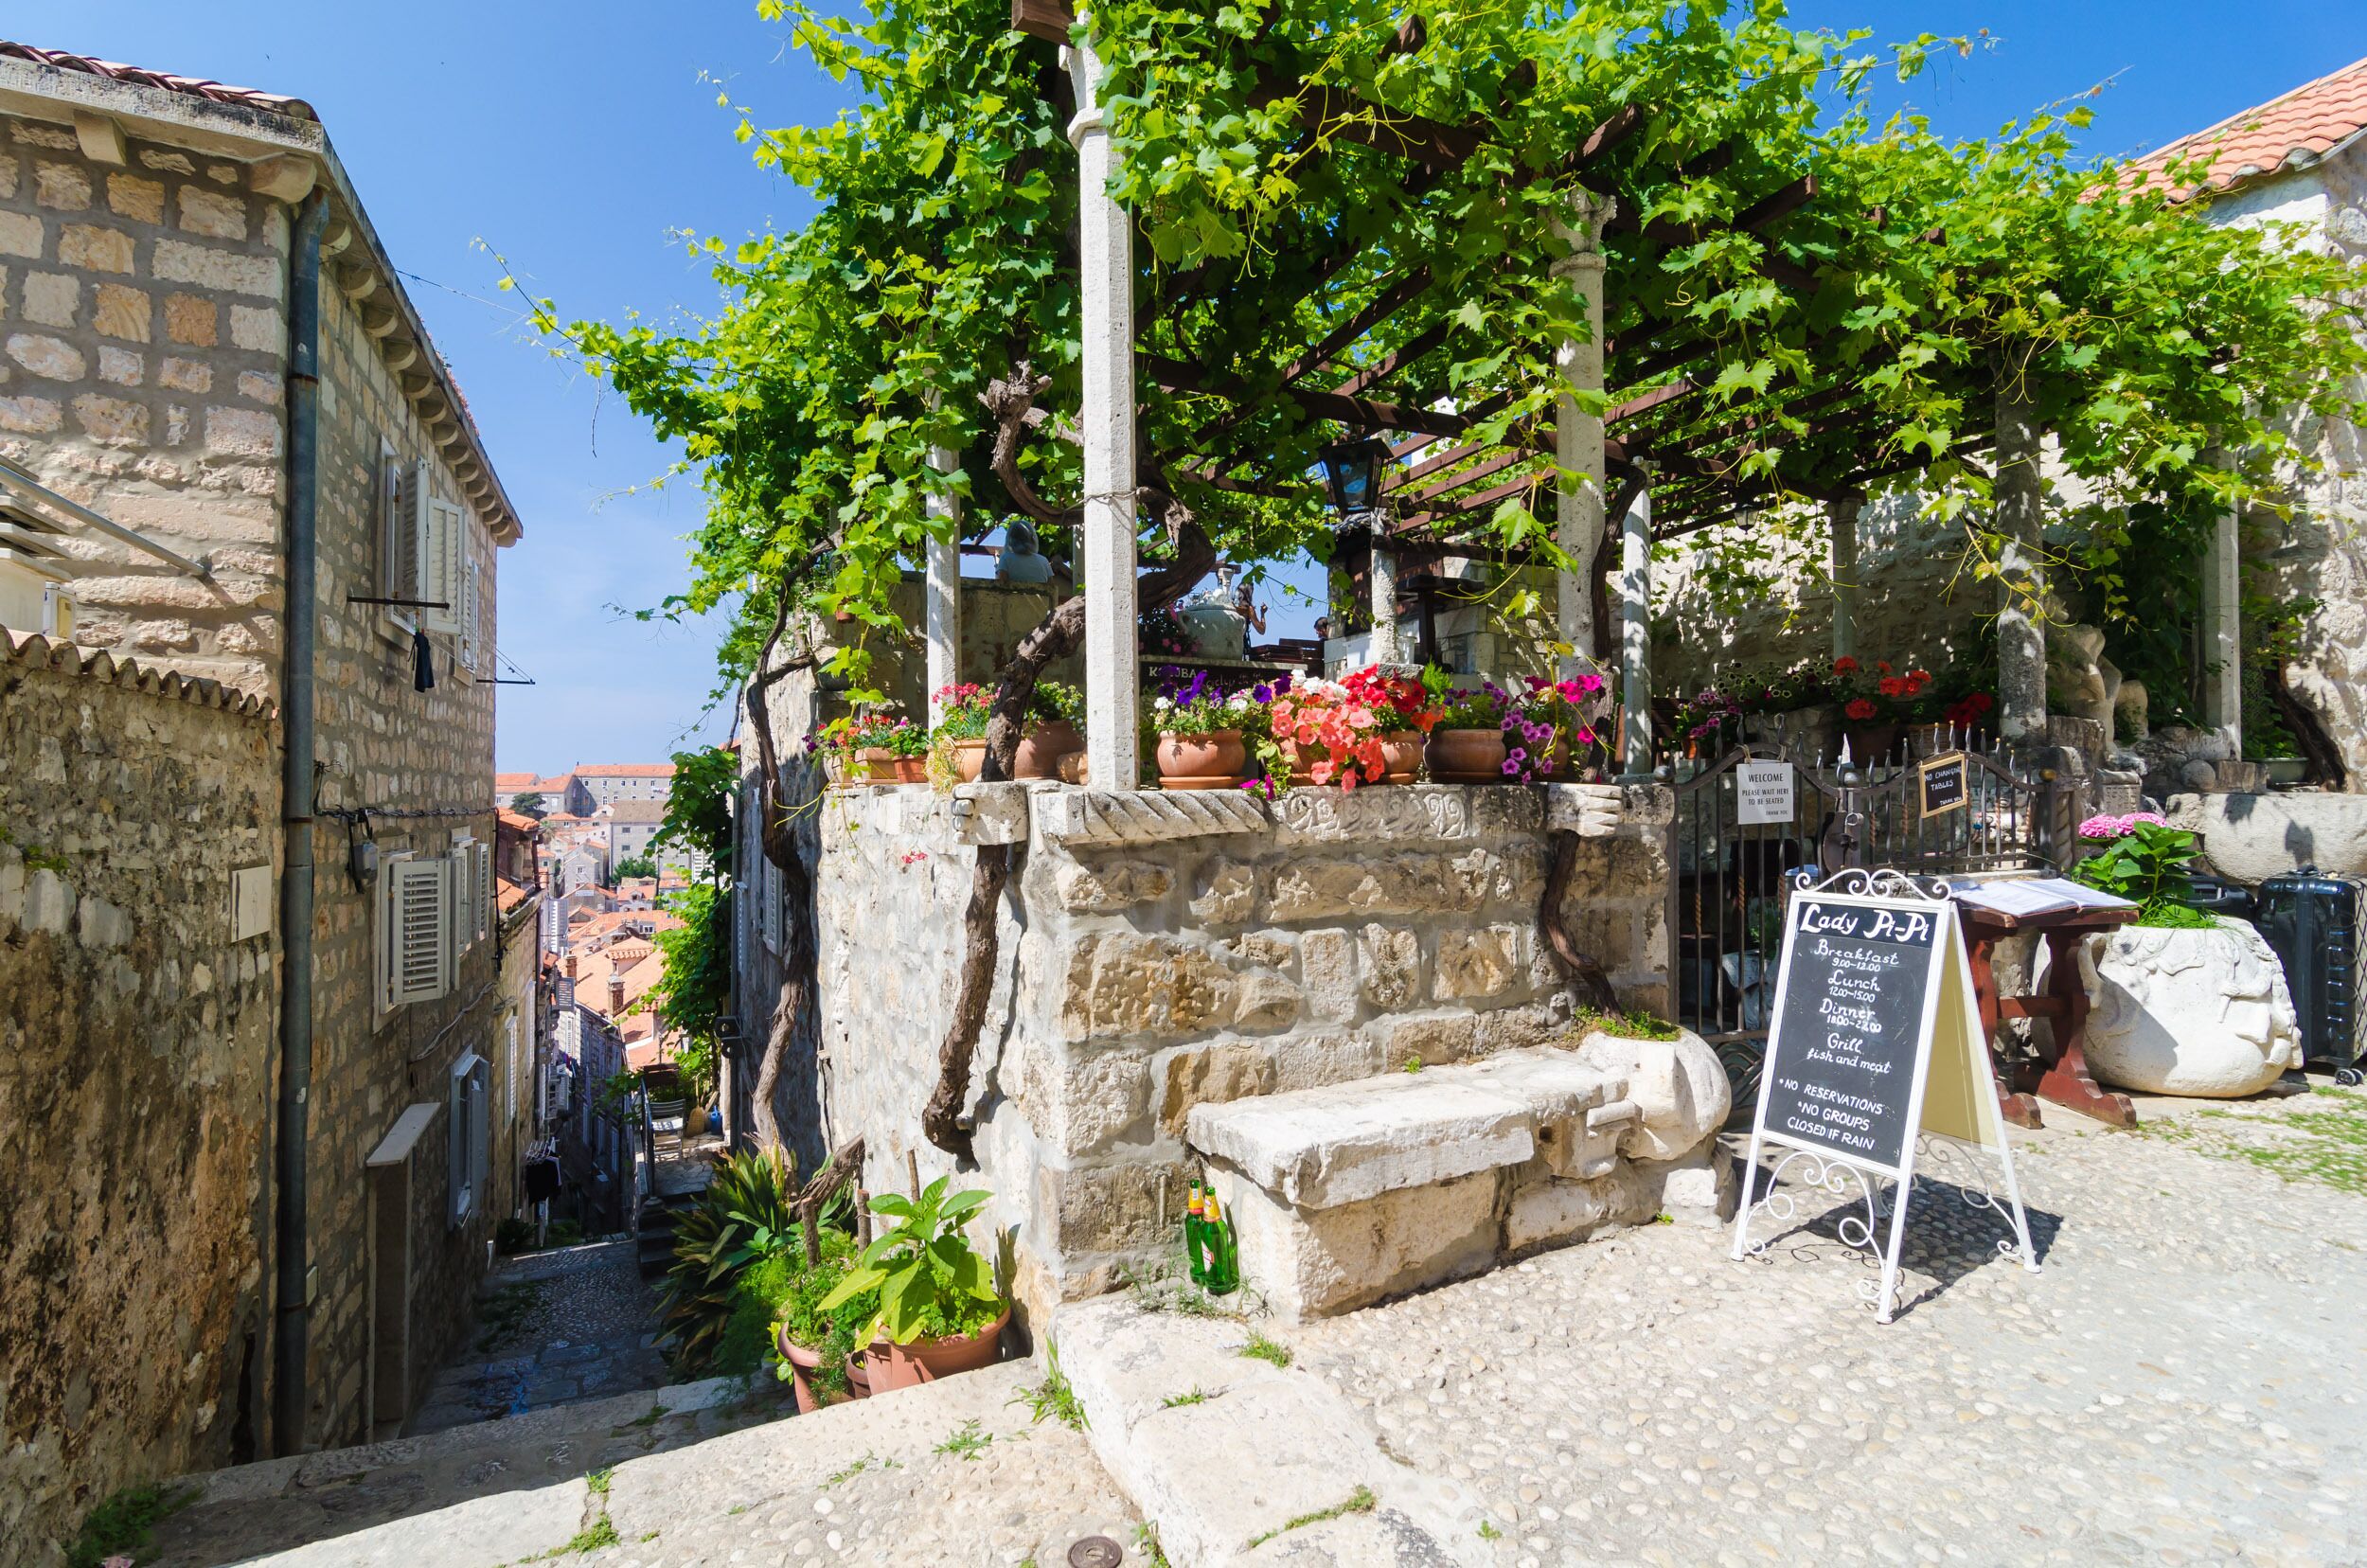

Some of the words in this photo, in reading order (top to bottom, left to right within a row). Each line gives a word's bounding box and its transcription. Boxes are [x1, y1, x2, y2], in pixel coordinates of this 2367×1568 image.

[1748, 773, 1785, 783] WELCOME
[1924, 773, 1933, 782] NO
[1931, 779, 1954, 792] TABLES
[1761, 788, 1775, 796] WAIT
[1799, 902, 1859, 935] Lady
[1862, 909, 1930, 942] Pi-Pi
[1814, 938, 1899, 965] Breakfast
[1827, 969, 1881, 992] Lunch
[1819, 997, 1877, 1021] Dinner
[1827, 1032, 1863, 1054] Grill
[1806, 1047, 1834, 1062] fish
[1835, 1055, 1860, 1067] and
[1860, 1060, 1893, 1074] meat
[1804, 1083, 1884, 1115] RESERVATIONS
[1822, 1108, 1871, 1131] GROUPS
[1787, 1116, 1826, 1137] CLOSED
[1828, 1128, 1841, 1141] IF
[1841, 1132, 1876, 1150] RAIN
